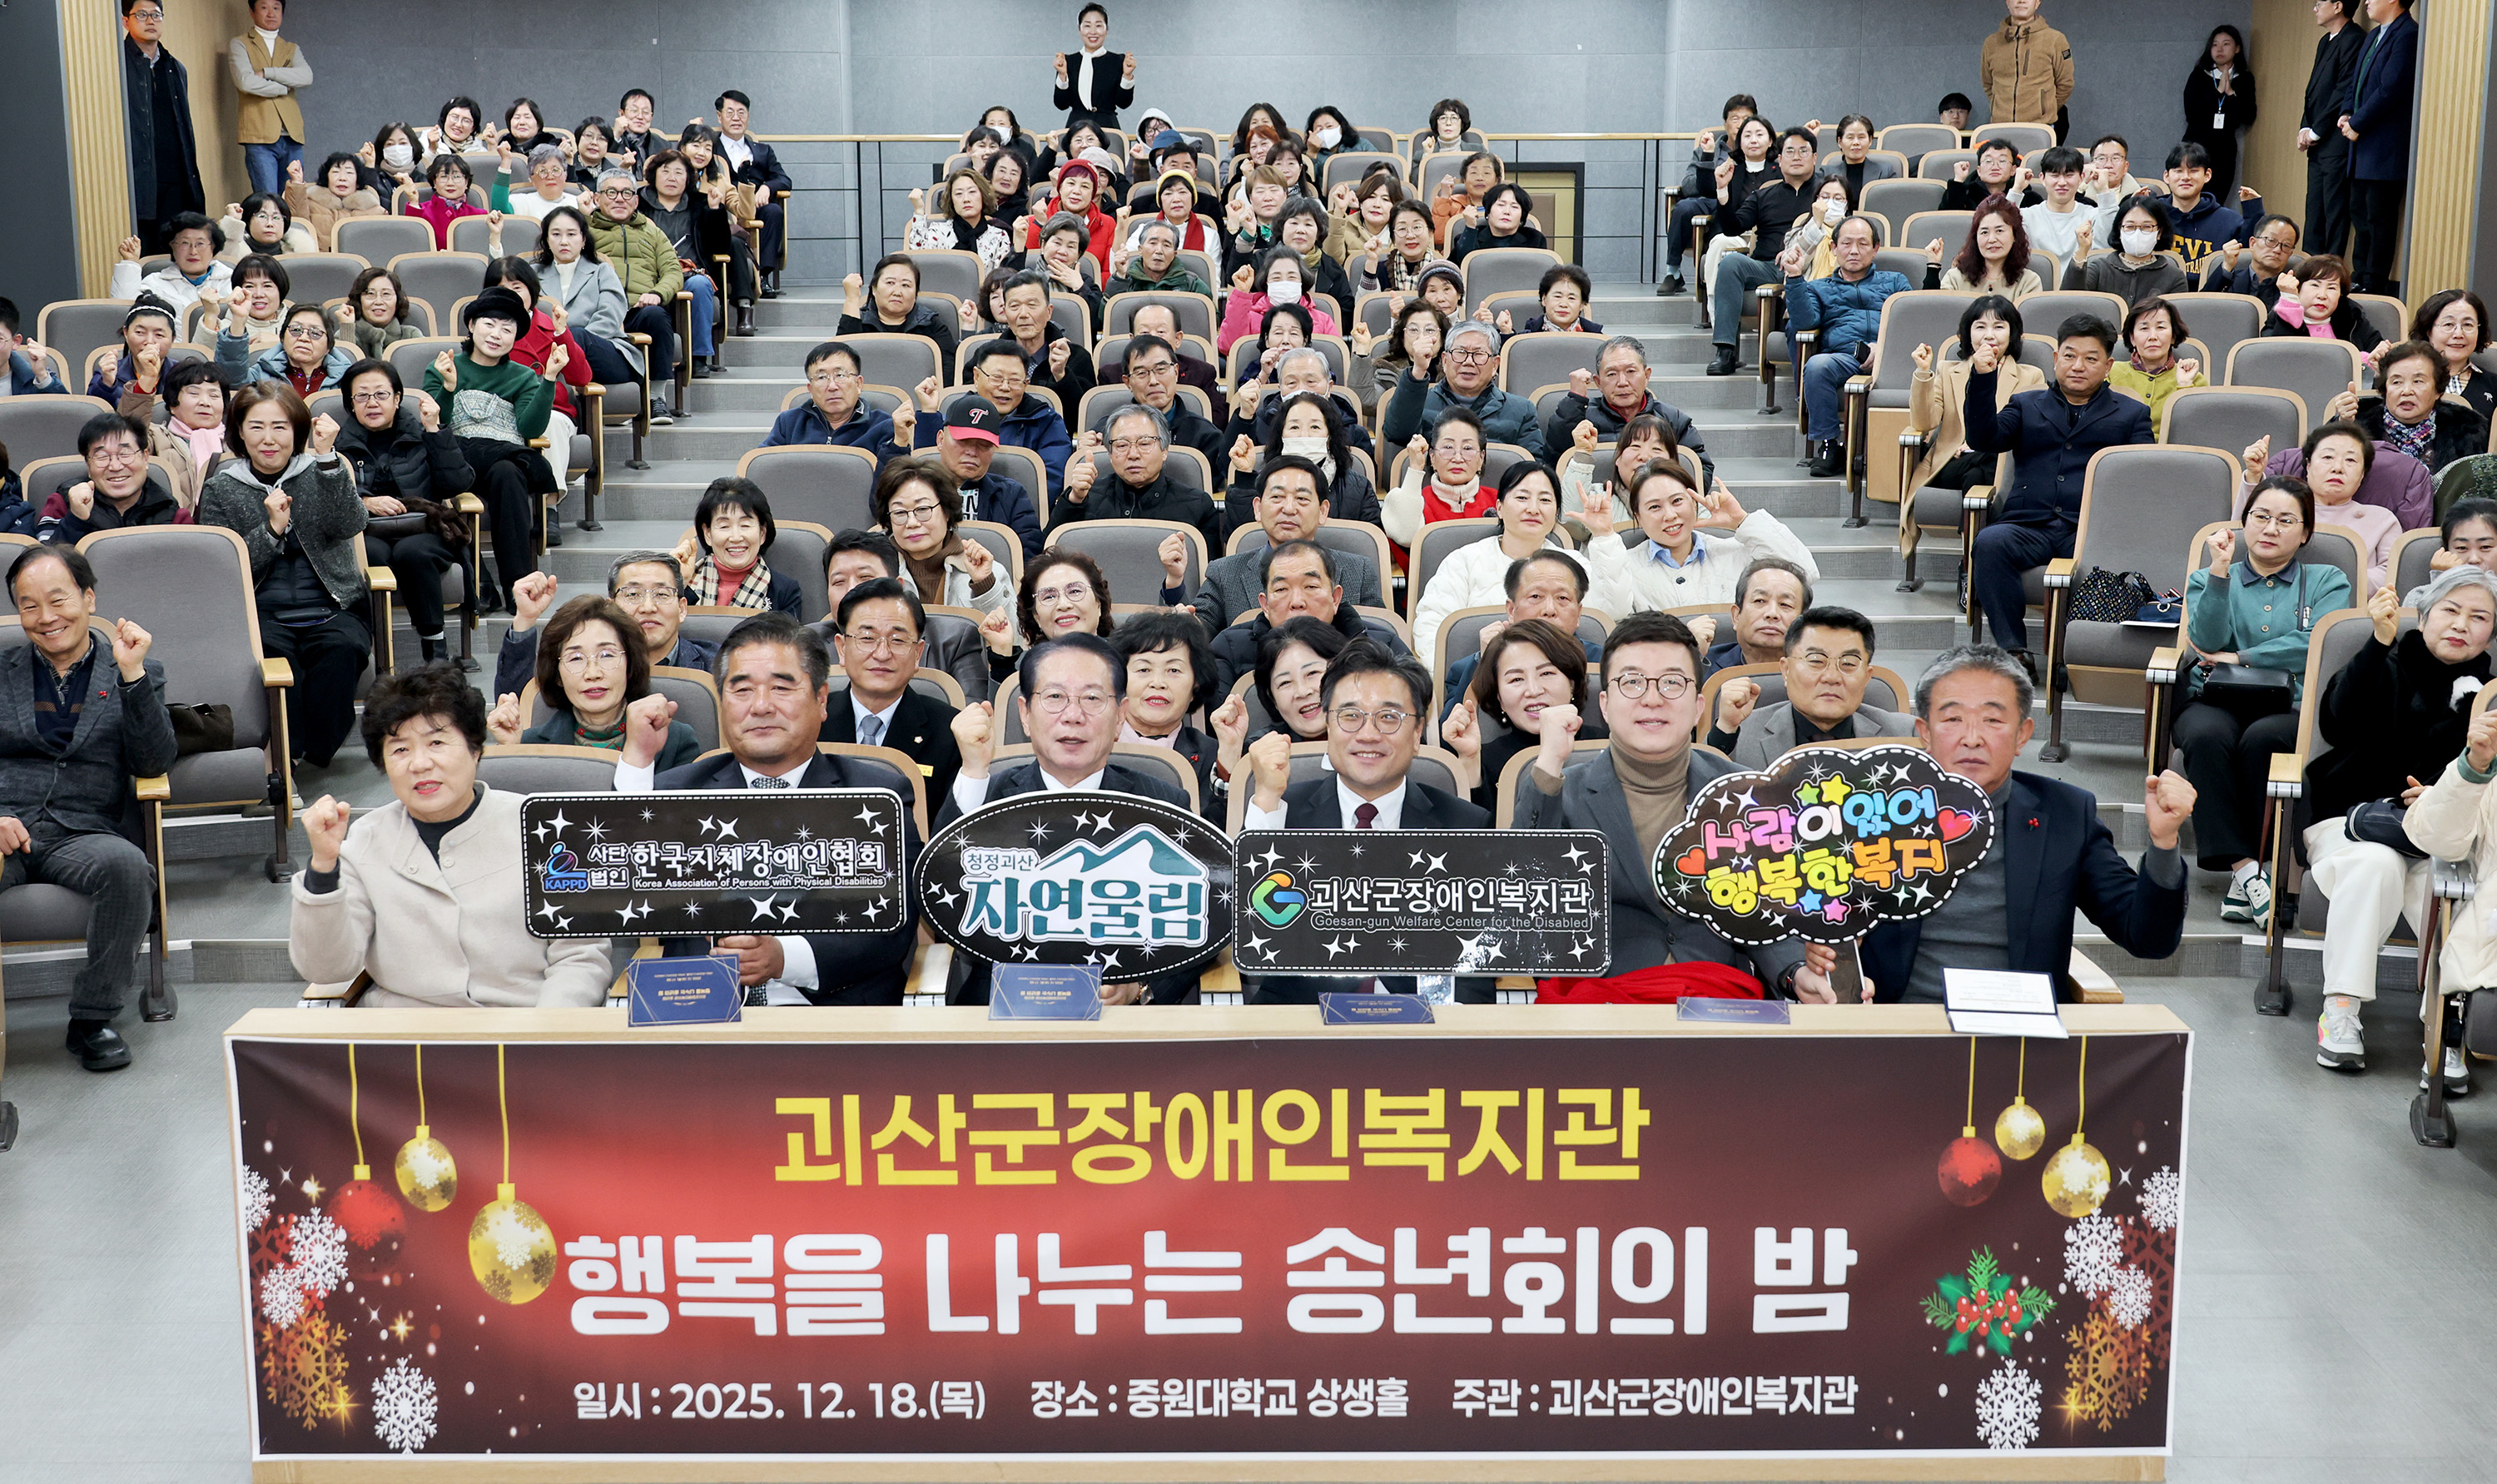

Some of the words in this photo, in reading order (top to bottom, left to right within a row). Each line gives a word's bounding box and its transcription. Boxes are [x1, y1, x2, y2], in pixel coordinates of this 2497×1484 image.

[1703, 805, 1843, 860] 사람이
[1842, 788, 1936, 838] 있어
[590, 845, 628, 862] 사단
[632, 840, 884, 878] 한국지체장애인협회
[590, 869, 628, 886] 법인
[966, 852, 1035, 872] 청정괴산
[1705, 847, 1854, 915] 행복한
[1853, 837, 1945, 888] 복지
[544, 879, 588, 890] KAPPD
[635, 879, 663, 888] Korea
[665, 878, 718, 887] Association
[720, 878, 730, 887] of
[732, 877, 770, 886] Persons
[772, 876, 792, 886] with
[794, 876, 832, 888] Physical
[835, 876, 884, 886] Disabilities
[1311, 880, 1591, 914] 괴산군장애인복지관
[964, 876, 1204, 941] 자연울림
[1314, 916, 1390, 929] Goesan-gun
[1394, 916, 1442, 926] Welfare
[1445, 916, 1487, 926] Center
[1491, 916, 1507, 926] for
[1512, 916, 1531, 927] the
[1535, 917, 1589, 928] Disabled
[774, 1086, 1651, 1187] 괴산군장애인복지관
[563, 1233, 886, 1338] 행복을
[925, 1229, 1244, 1336] 나누는
[1285, 1225, 1709, 1336] 송년회의
[1752, 1226, 1859, 1333] 밤
[573, 1382, 641, 1420] 일시
[669, 1382, 785, 1420] 2025.
[797, 1382, 856, 1418] 12.
[868, 1380, 986, 1420] 18.(목)
[1030, 1380, 1099, 1419] 장소
[1127, 1377, 1298, 1419] 중원대학교
[1307, 1377, 1409, 1418] 상생홀
[1452, 1378, 1522, 1418] 주관
[1548, 1375, 1859, 1417] 괴산군장애인복지관
